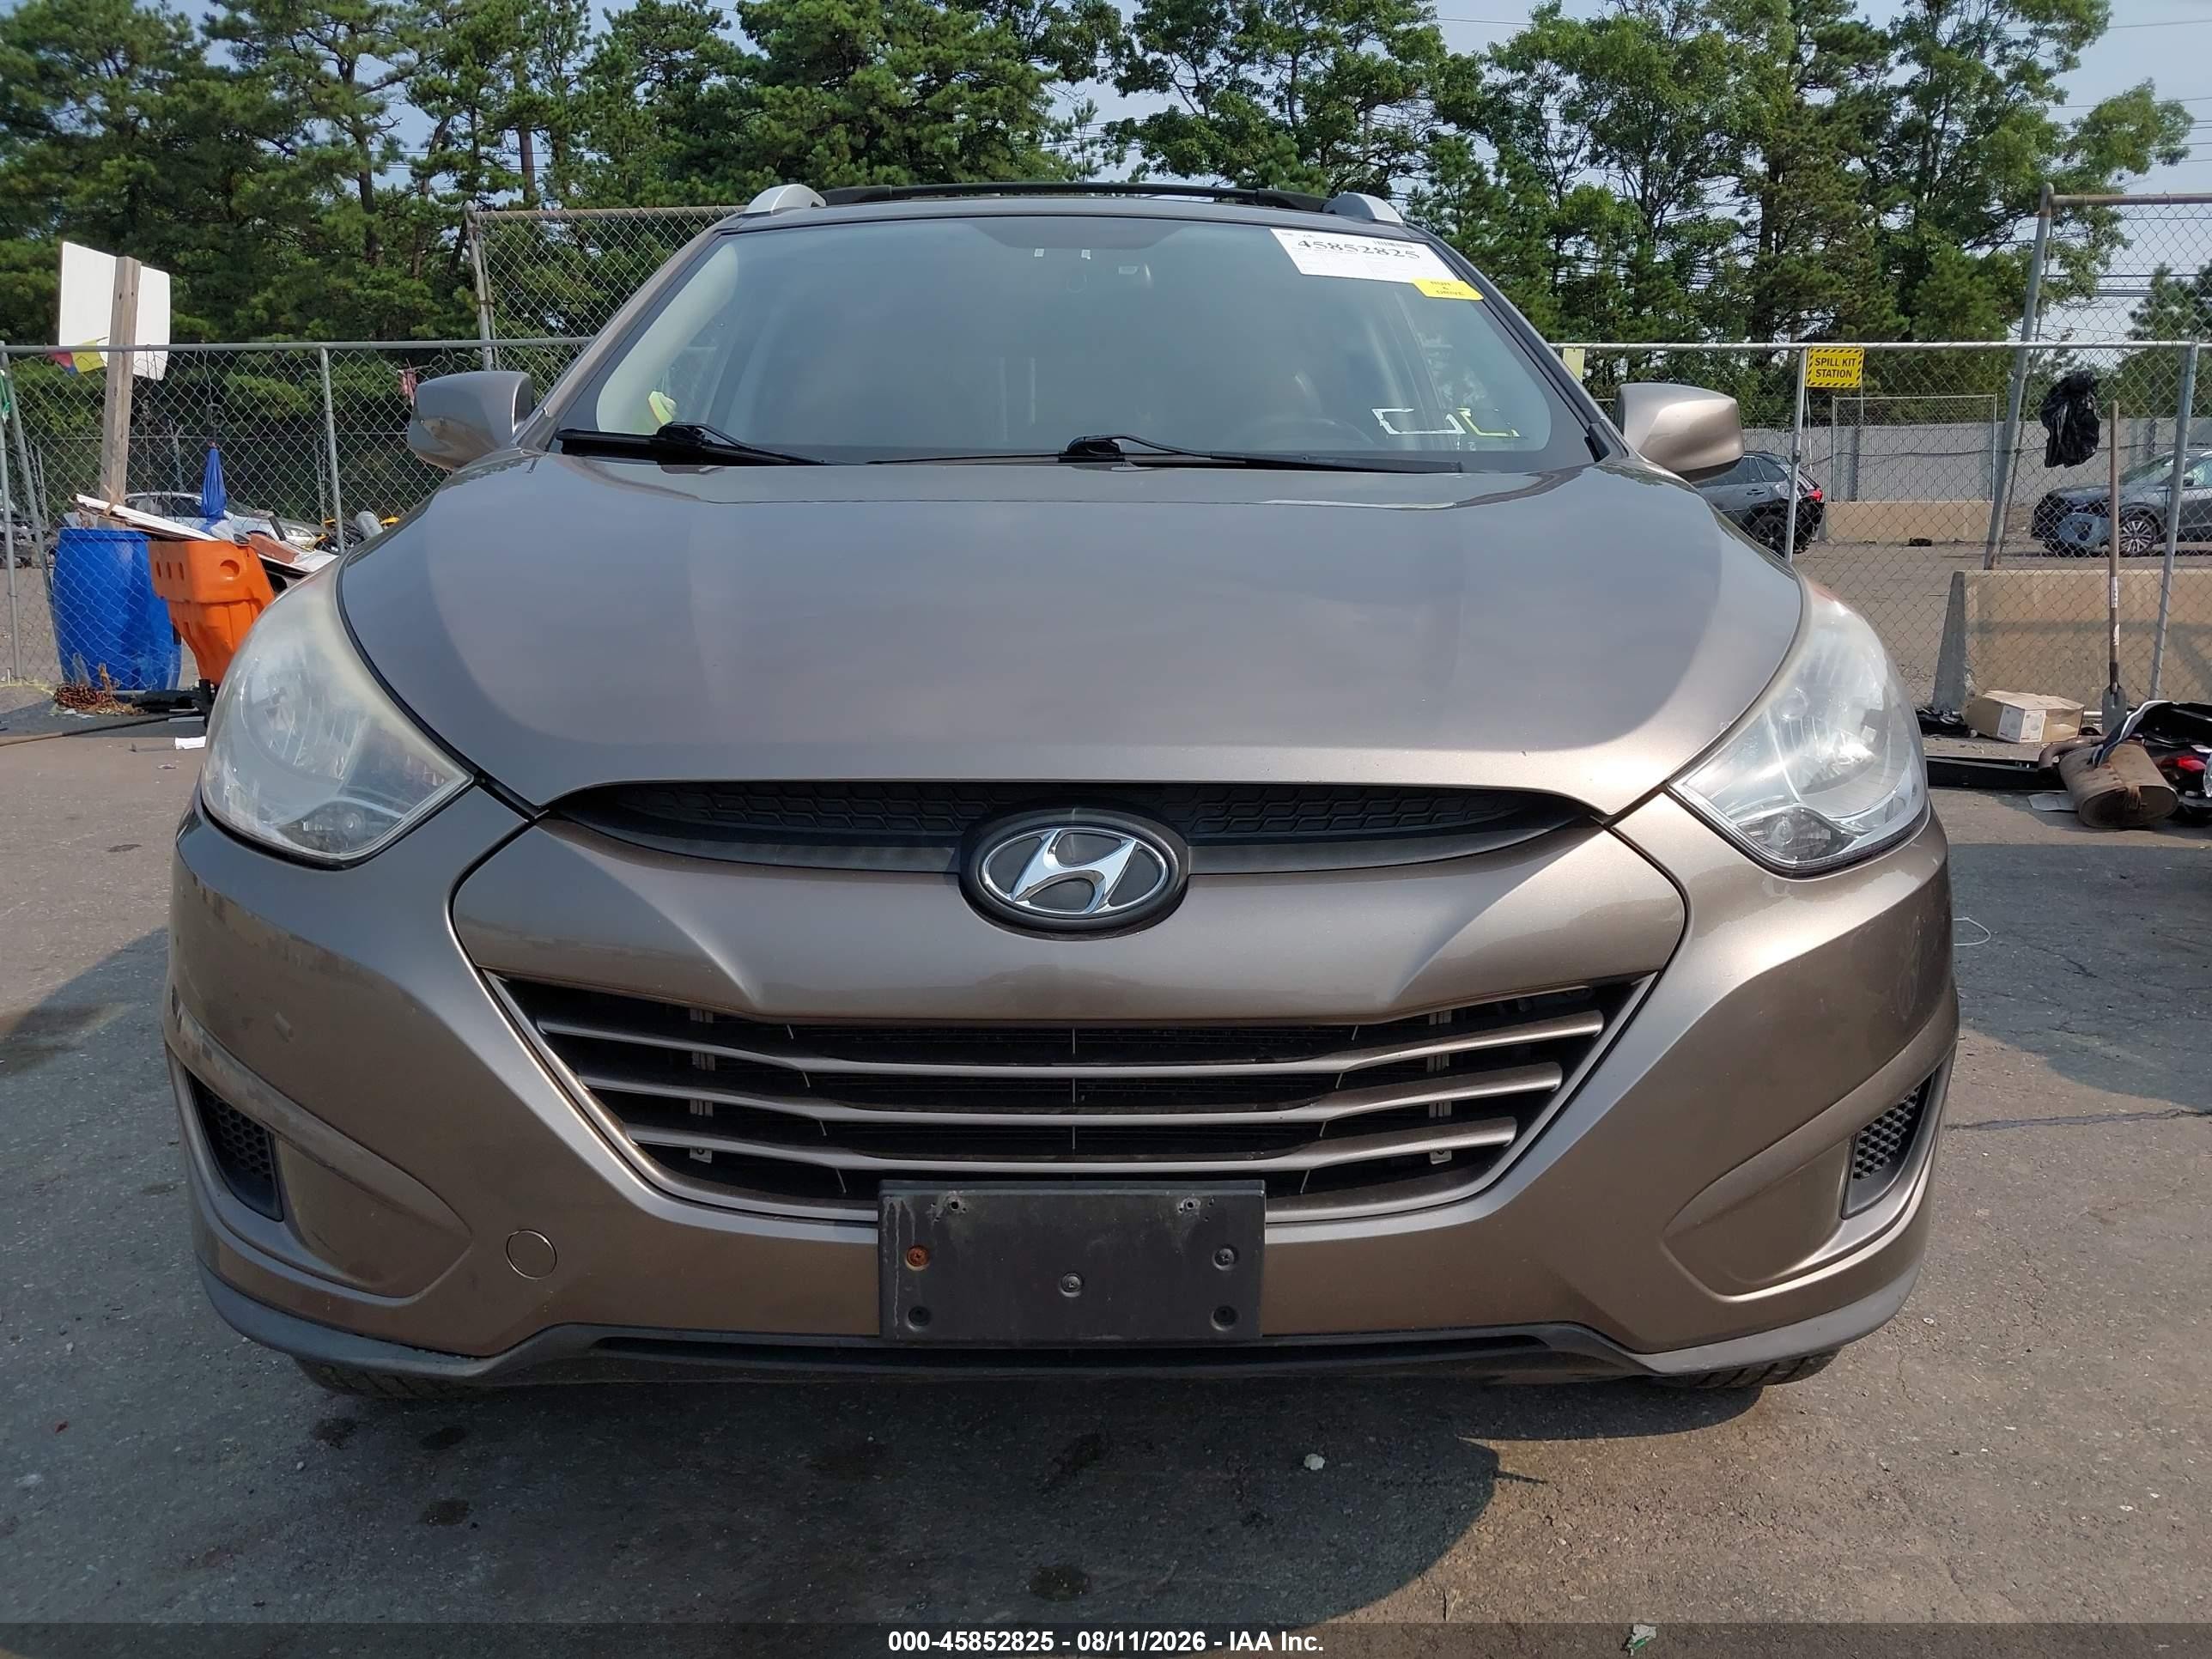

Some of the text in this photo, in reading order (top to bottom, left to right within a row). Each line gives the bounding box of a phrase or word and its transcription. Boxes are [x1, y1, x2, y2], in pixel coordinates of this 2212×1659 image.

[1297, 240, 1420, 259] 45852825
[1814, 357, 1856, 367] SPILL KIT
[1815, 368, 1852, 378] STATION
